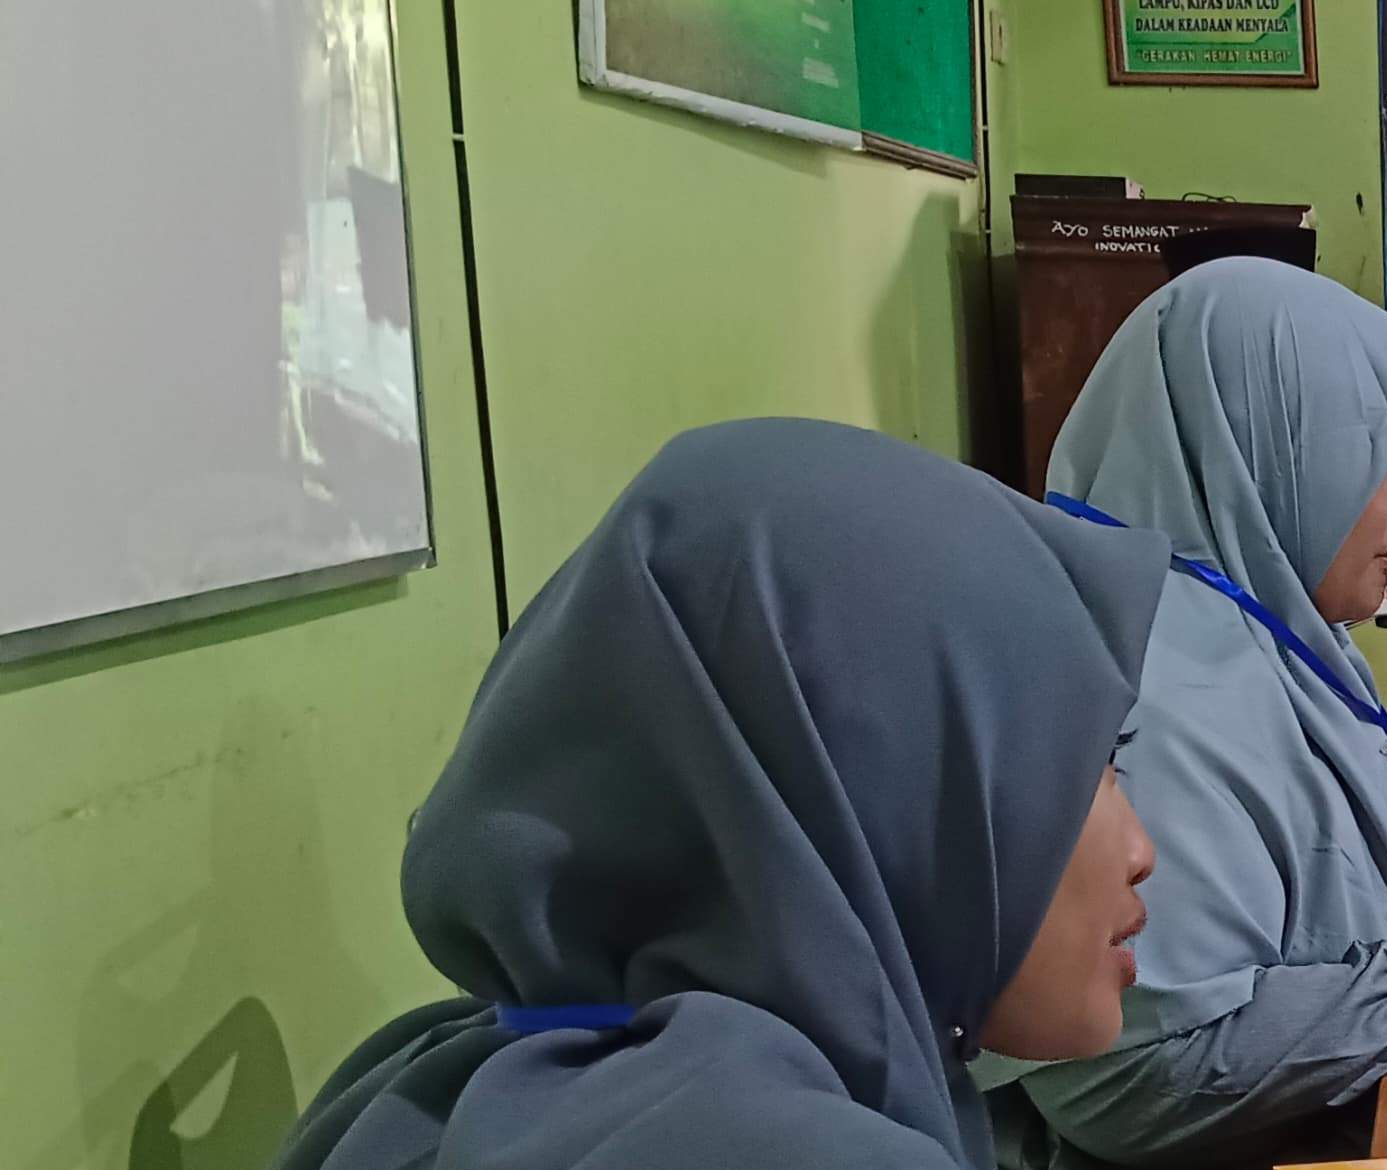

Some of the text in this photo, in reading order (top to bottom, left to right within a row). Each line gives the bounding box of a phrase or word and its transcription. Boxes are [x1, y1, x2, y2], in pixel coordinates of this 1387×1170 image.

[1226, 0, 1253, 9] DAN
[1257, 0, 1279, 9] LCD
[1135, 18, 1289, 33] DALAM KEADAAN MENYALA
[1204, 51, 1240, 63] HEMAT
[1051, 220, 1088, 237] AYO
[1102, 225, 1180, 238] SEMANGAT
